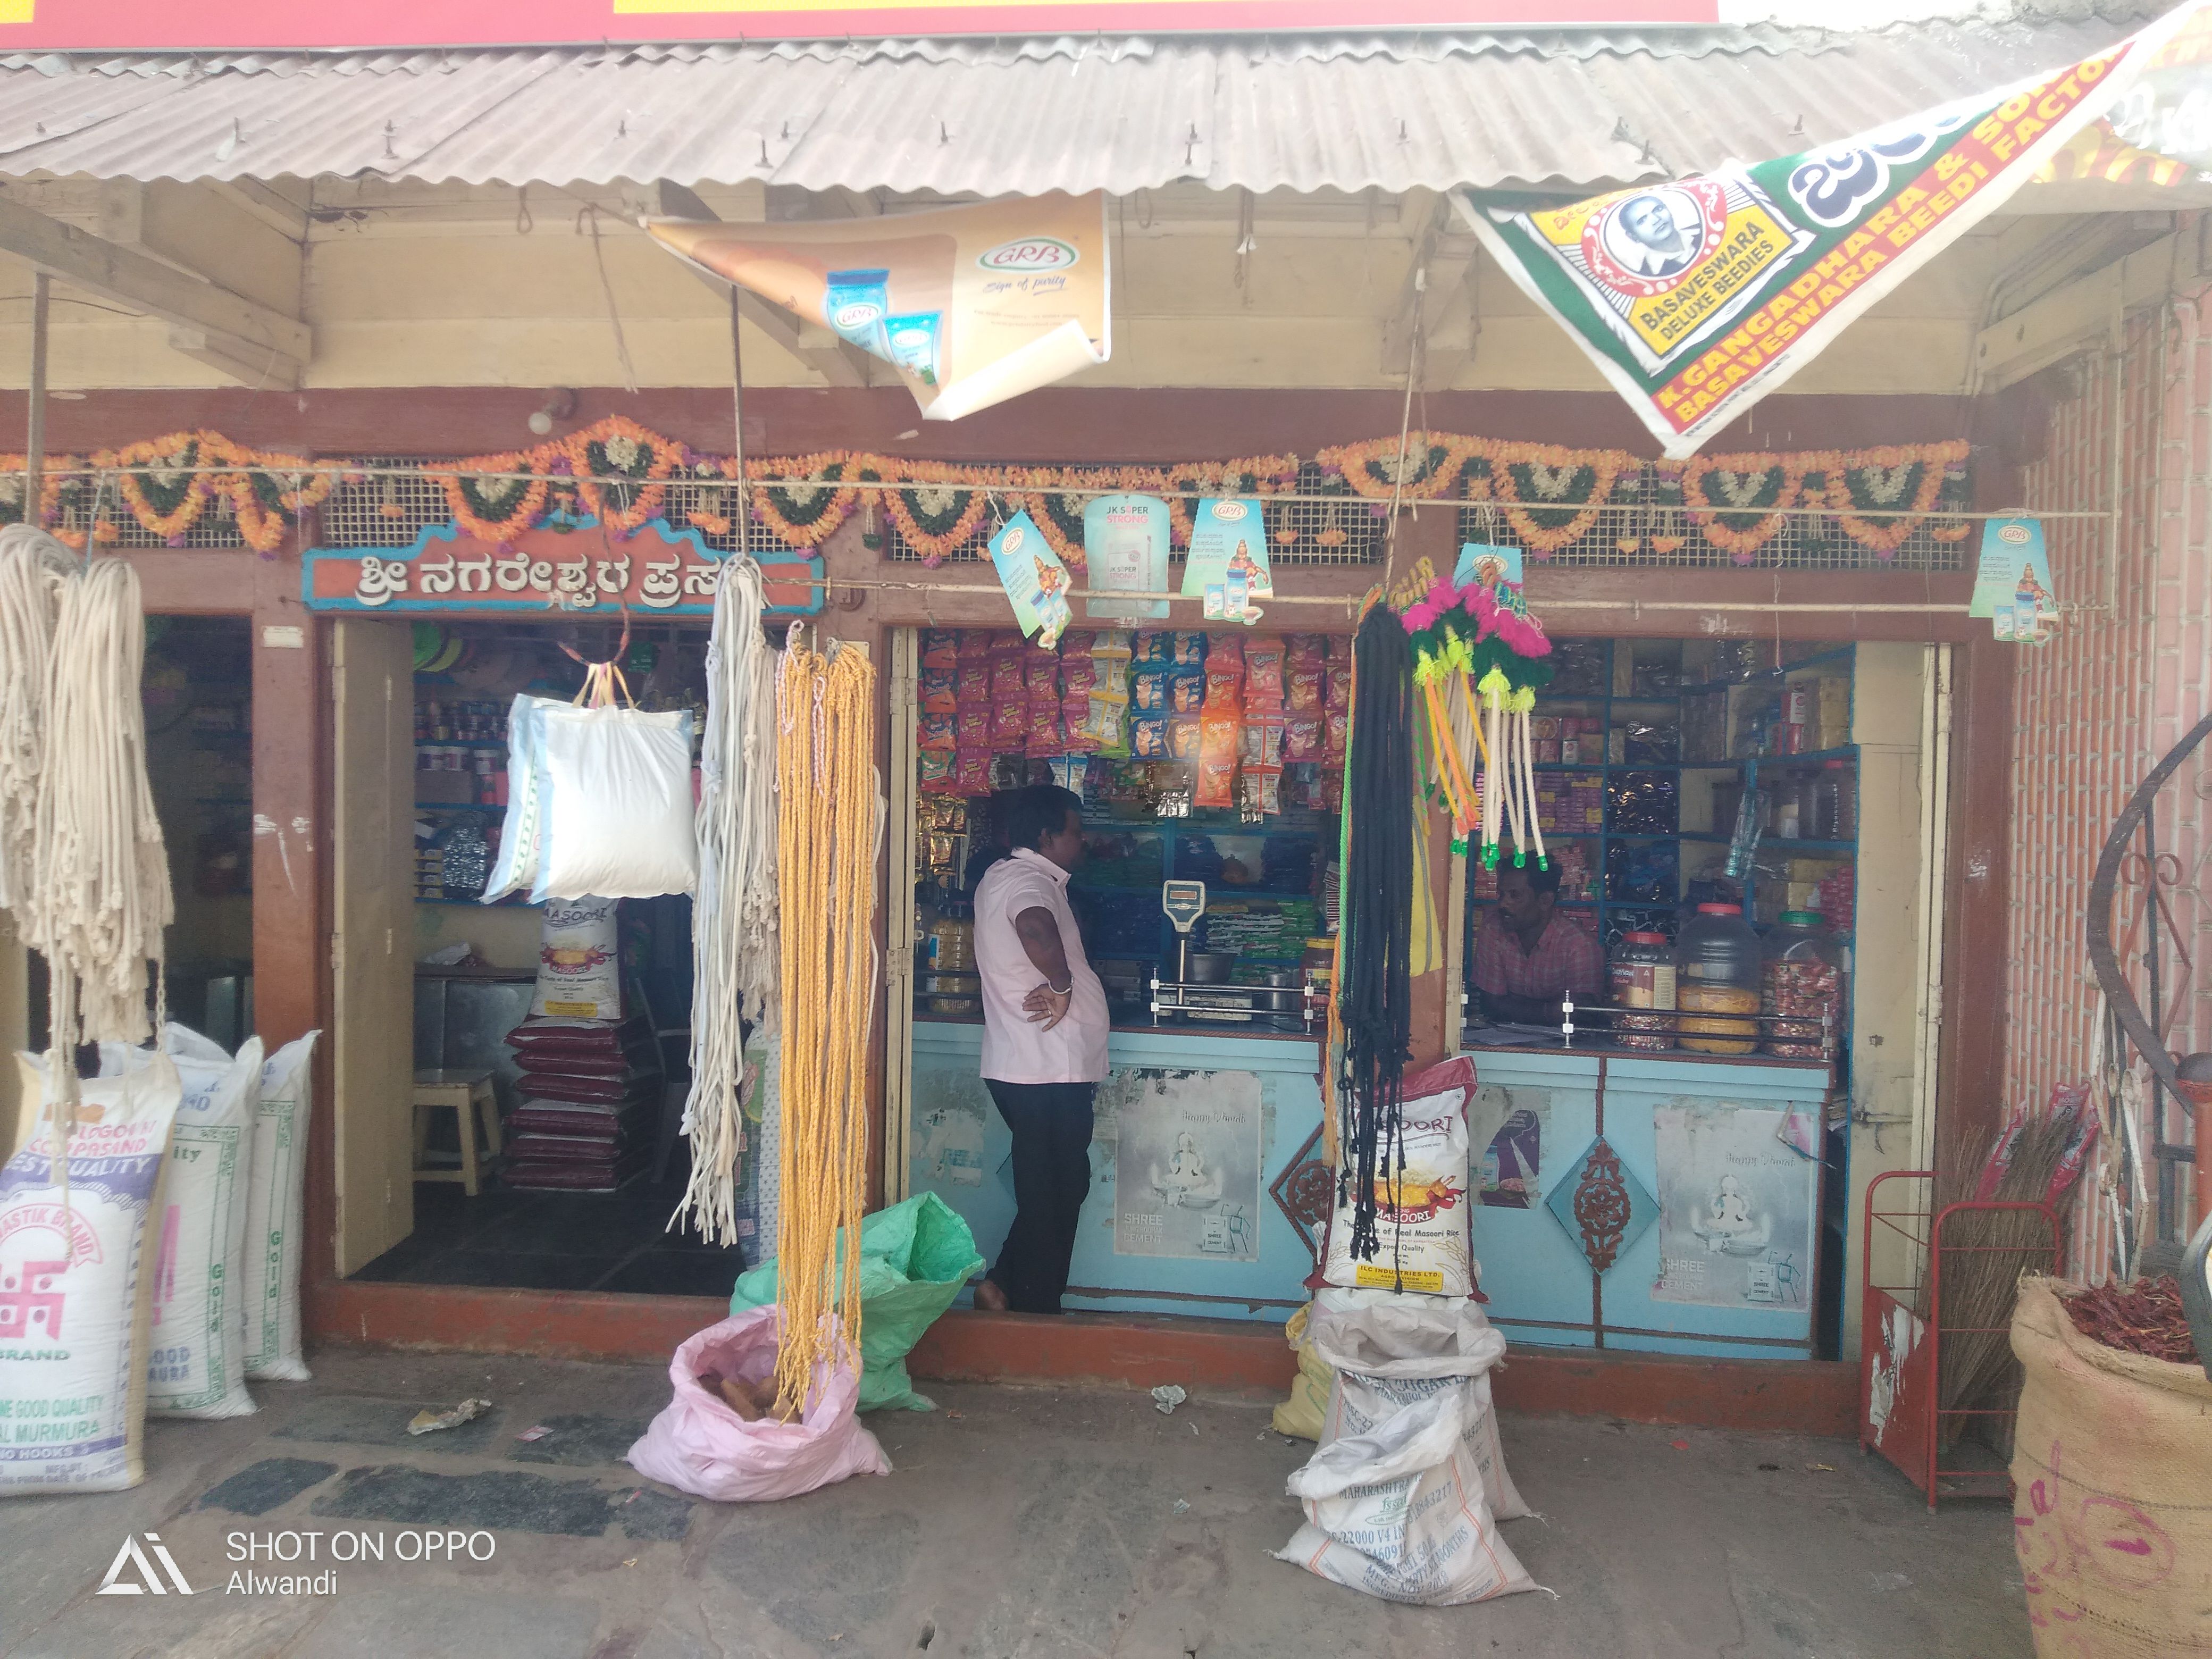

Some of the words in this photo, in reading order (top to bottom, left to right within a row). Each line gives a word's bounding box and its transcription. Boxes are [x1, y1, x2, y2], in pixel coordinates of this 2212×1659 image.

[993, 245, 1060, 265] GRB
[1640, 221, 1765, 332] BASAVESWARA
[1657, 186, 1930, 409] K.GANGADHARA
[1936, 153, 1970, 182] &
[983, 282, 1012, 293] Sign
[1017, 276, 1029, 292] of
[1032, 275, 1066, 290] purity
[1661, 291, 1716, 341] DELUXE
[1713, 240, 1774, 295] BEEDIES
[1675, 250, 1889, 424] BASAVESWARA
[1891, 164, 1991, 250] BEEDI
[1218, 506, 1241, 516] GRB
[1107, 515, 1149, 524] STRONG
[1006, 532, 1020, 550] GRB
[2004, 530, 2025, 539] GRB
[354, 555, 408, 607] ಶ್ರೀ
[420, 551, 631, 608] ನಗರೇಶ್ವರ
[1254, 653, 1278, 665] BINGO!
[1139, 672, 1162, 684] BINGO!
[1176, 675, 1200, 688] BINGO!
[1211, 674, 1234, 685] BINGO!
[1295, 673, 1319, 685] BINGO!
[1337, 672, 1351, 683] BIN
[1139, 719, 1162, 732] BINGO!
[1208, 721, 1231, 733] BINGO!
[1294, 722, 1317, 733] BINGO!
[1335, 716, 1348, 726] BIN
[1177, 723, 1200, 734] BINGO!
[1208, 764, 1231, 774] BINGO!
[66, 1156, 152, 1177] UALITY
[1124, 1213, 1163, 1226] SHREE
[1124, 1234, 1163, 1244] CEMENT
[1414, 1229, 1444, 1238] Masoori
[1402, 1244, 1425, 1253] Quality
[1666, 1259, 1705, 1272] SHREE
[1662, 1279, 1703, 1291] CEMENT
[153, 1346, 190, 1364] OOD
[16, 1400, 51, 1419] GOOD
[15, 1420, 100, 1443] MURMURA
[1339, 1479, 1409, 1499] MAHARASHTRA
[1377, 1530, 1389, 1543] V4
